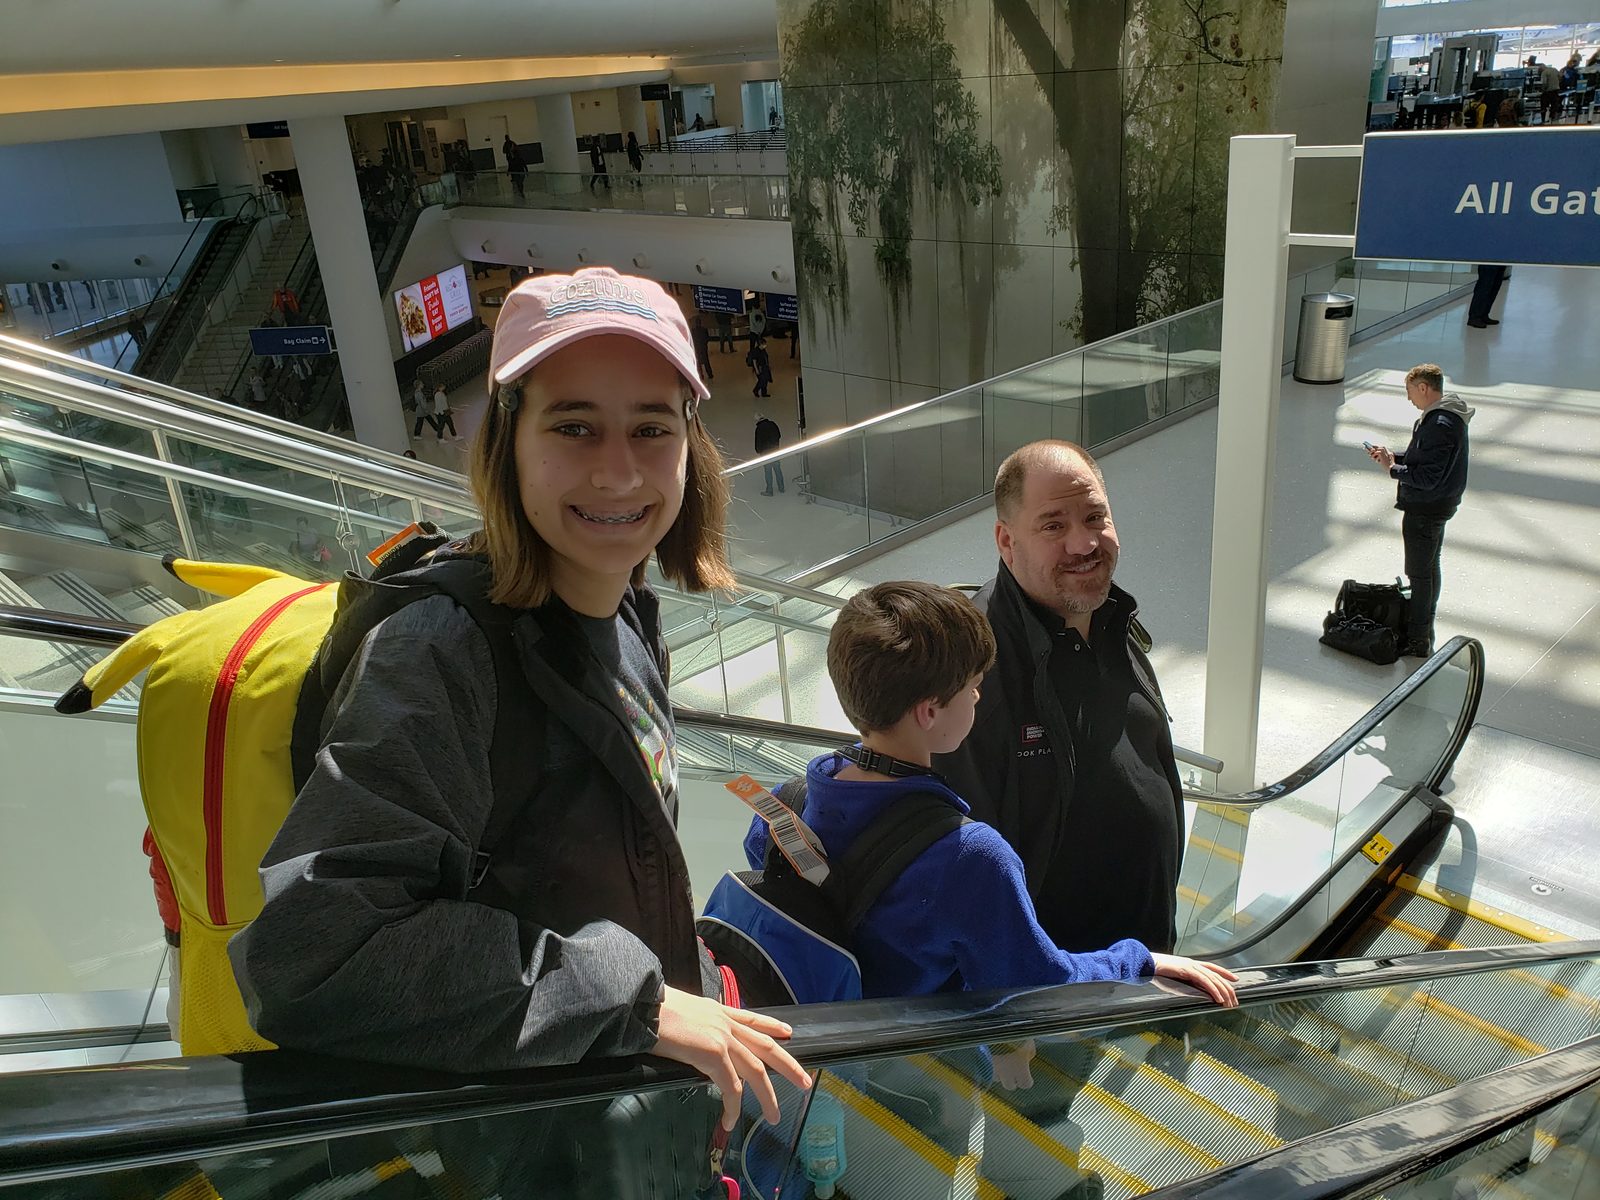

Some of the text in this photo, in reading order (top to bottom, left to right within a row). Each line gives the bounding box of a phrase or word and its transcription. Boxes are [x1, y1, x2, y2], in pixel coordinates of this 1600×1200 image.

[1454, 181, 1513, 214] All
[283, 338, 295, 346] Bag
[1038, 747, 1052, 755] PLA
